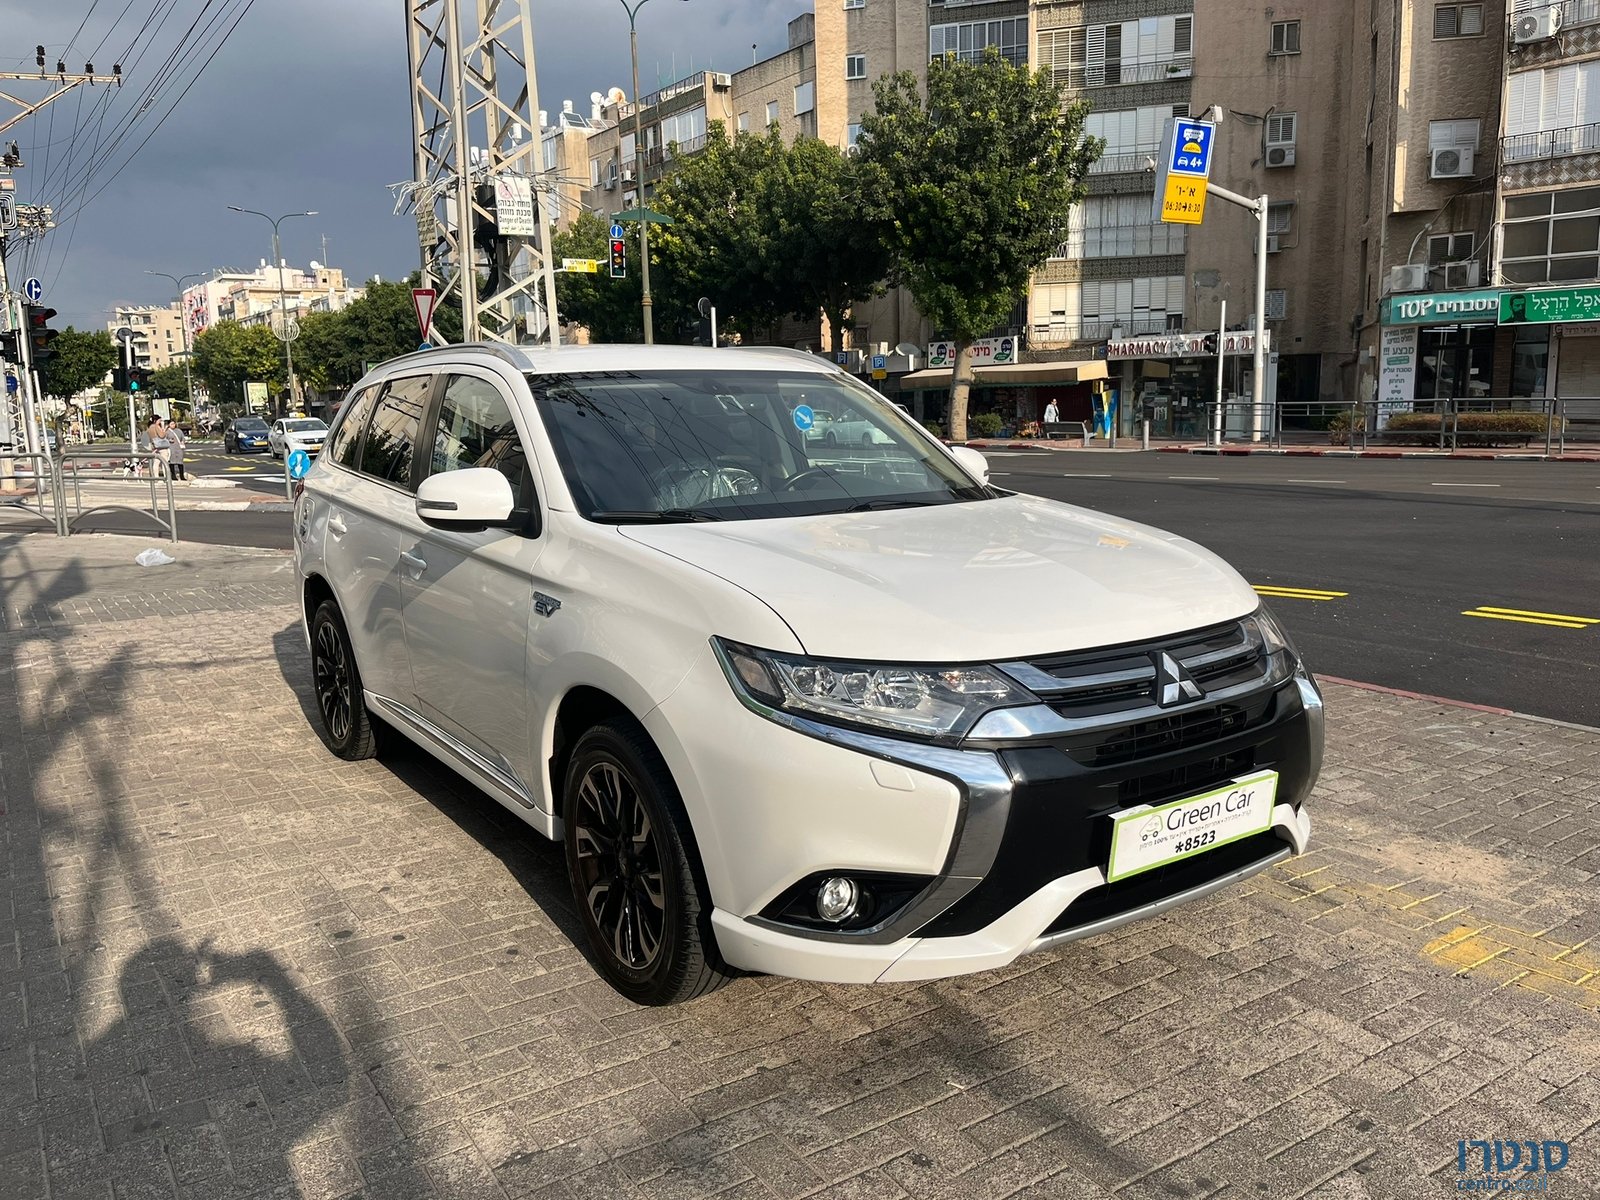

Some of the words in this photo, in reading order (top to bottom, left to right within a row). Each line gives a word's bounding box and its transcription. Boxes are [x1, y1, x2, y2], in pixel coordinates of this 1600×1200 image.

[498, 216, 513, 224] Danger
[1398, 298, 1434, 318] TOP
[1435, 298, 1499, 313] מטבחים
[973, 346, 990, 356] מיני
[1107, 341, 1168, 356] PHARMACY
[1392, 346, 1414, 355] מבצע
[1166, 801, 1221, 831] Green
[1225, 790, 1255, 812] Car
